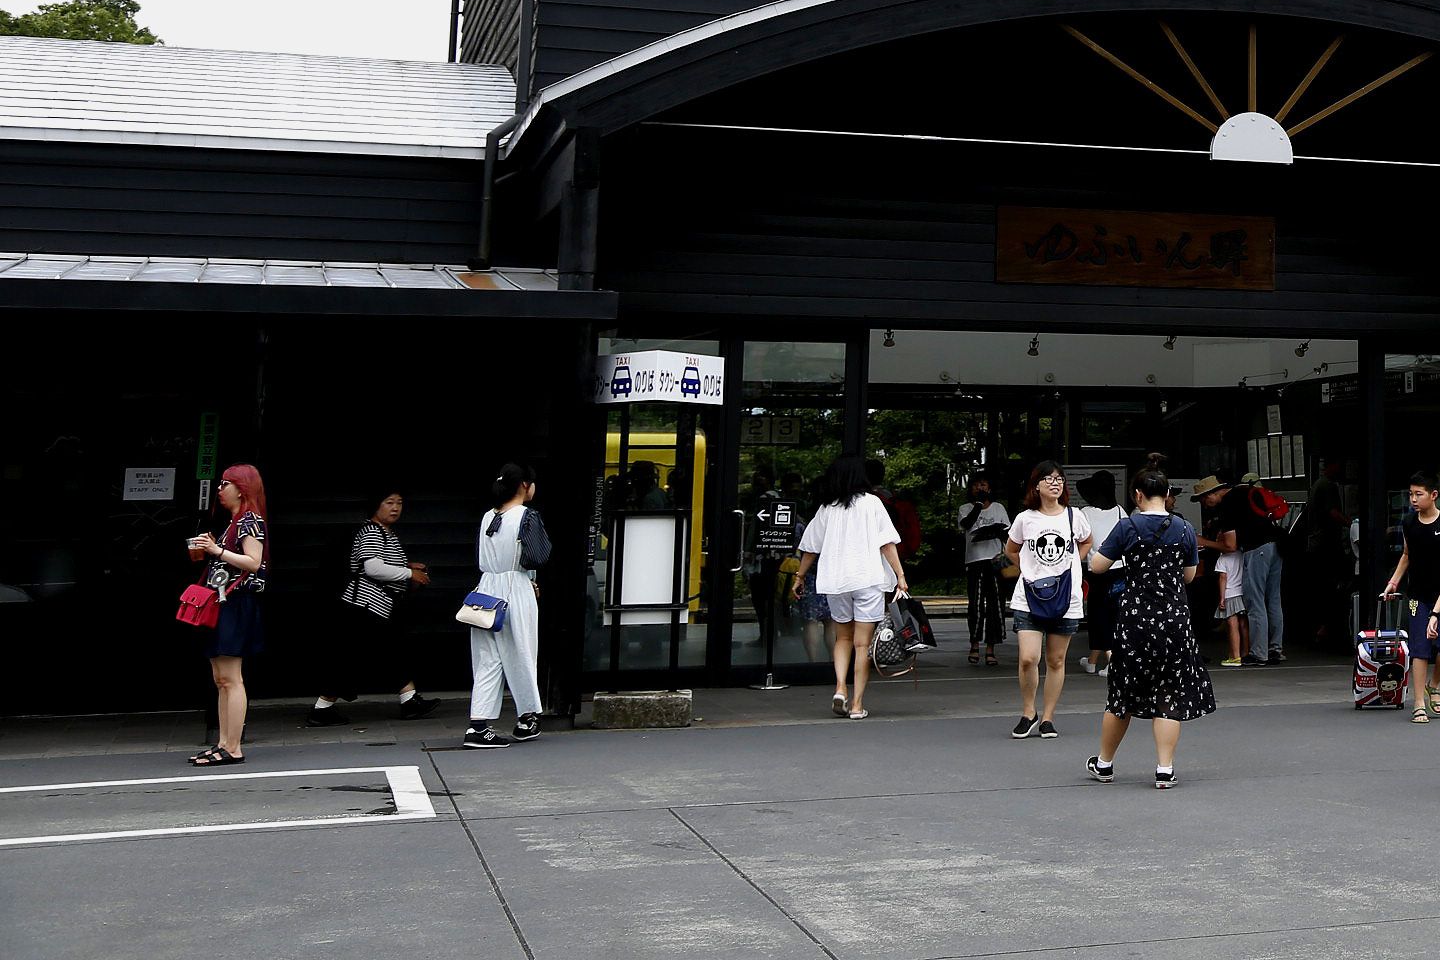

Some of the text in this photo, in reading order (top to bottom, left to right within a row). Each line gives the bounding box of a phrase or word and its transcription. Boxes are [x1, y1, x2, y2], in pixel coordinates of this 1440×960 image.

[616, 356, 631, 366] TAXI
[685, 356, 700, 366] TAXI
[634, 370, 654, 393] のりば
[659, 369, 721, 397] タクシー のりば
[749, 419, 763, 435] 2
[779, 419, 793, 435] 3
